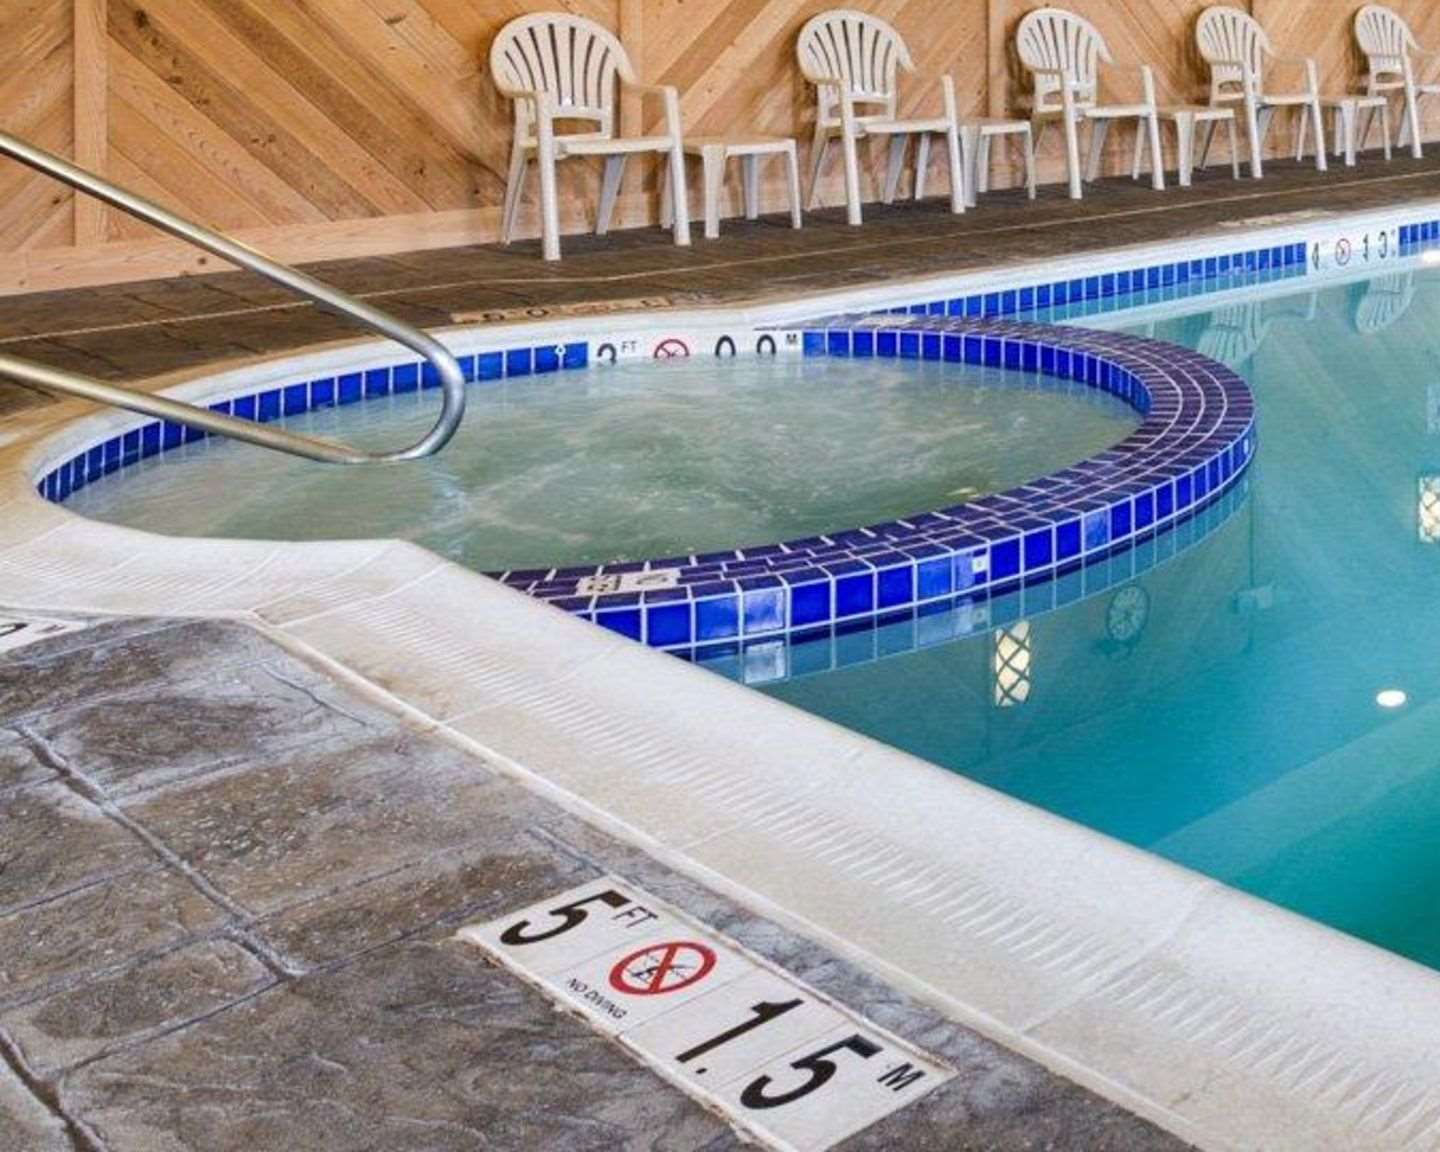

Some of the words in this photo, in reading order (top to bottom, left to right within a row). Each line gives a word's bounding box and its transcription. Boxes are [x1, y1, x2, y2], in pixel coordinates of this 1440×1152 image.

[621, 340, 637, 352] FT
[501, 890, 632, 945] 5
[612, 906, 658, 928] FT
[567, 977, 588, 993] NO
[584, 989, 627, 1020] DIVING
[675, 998, 884, 1110] 1.5
[876, 1061, 926, 1092] M
